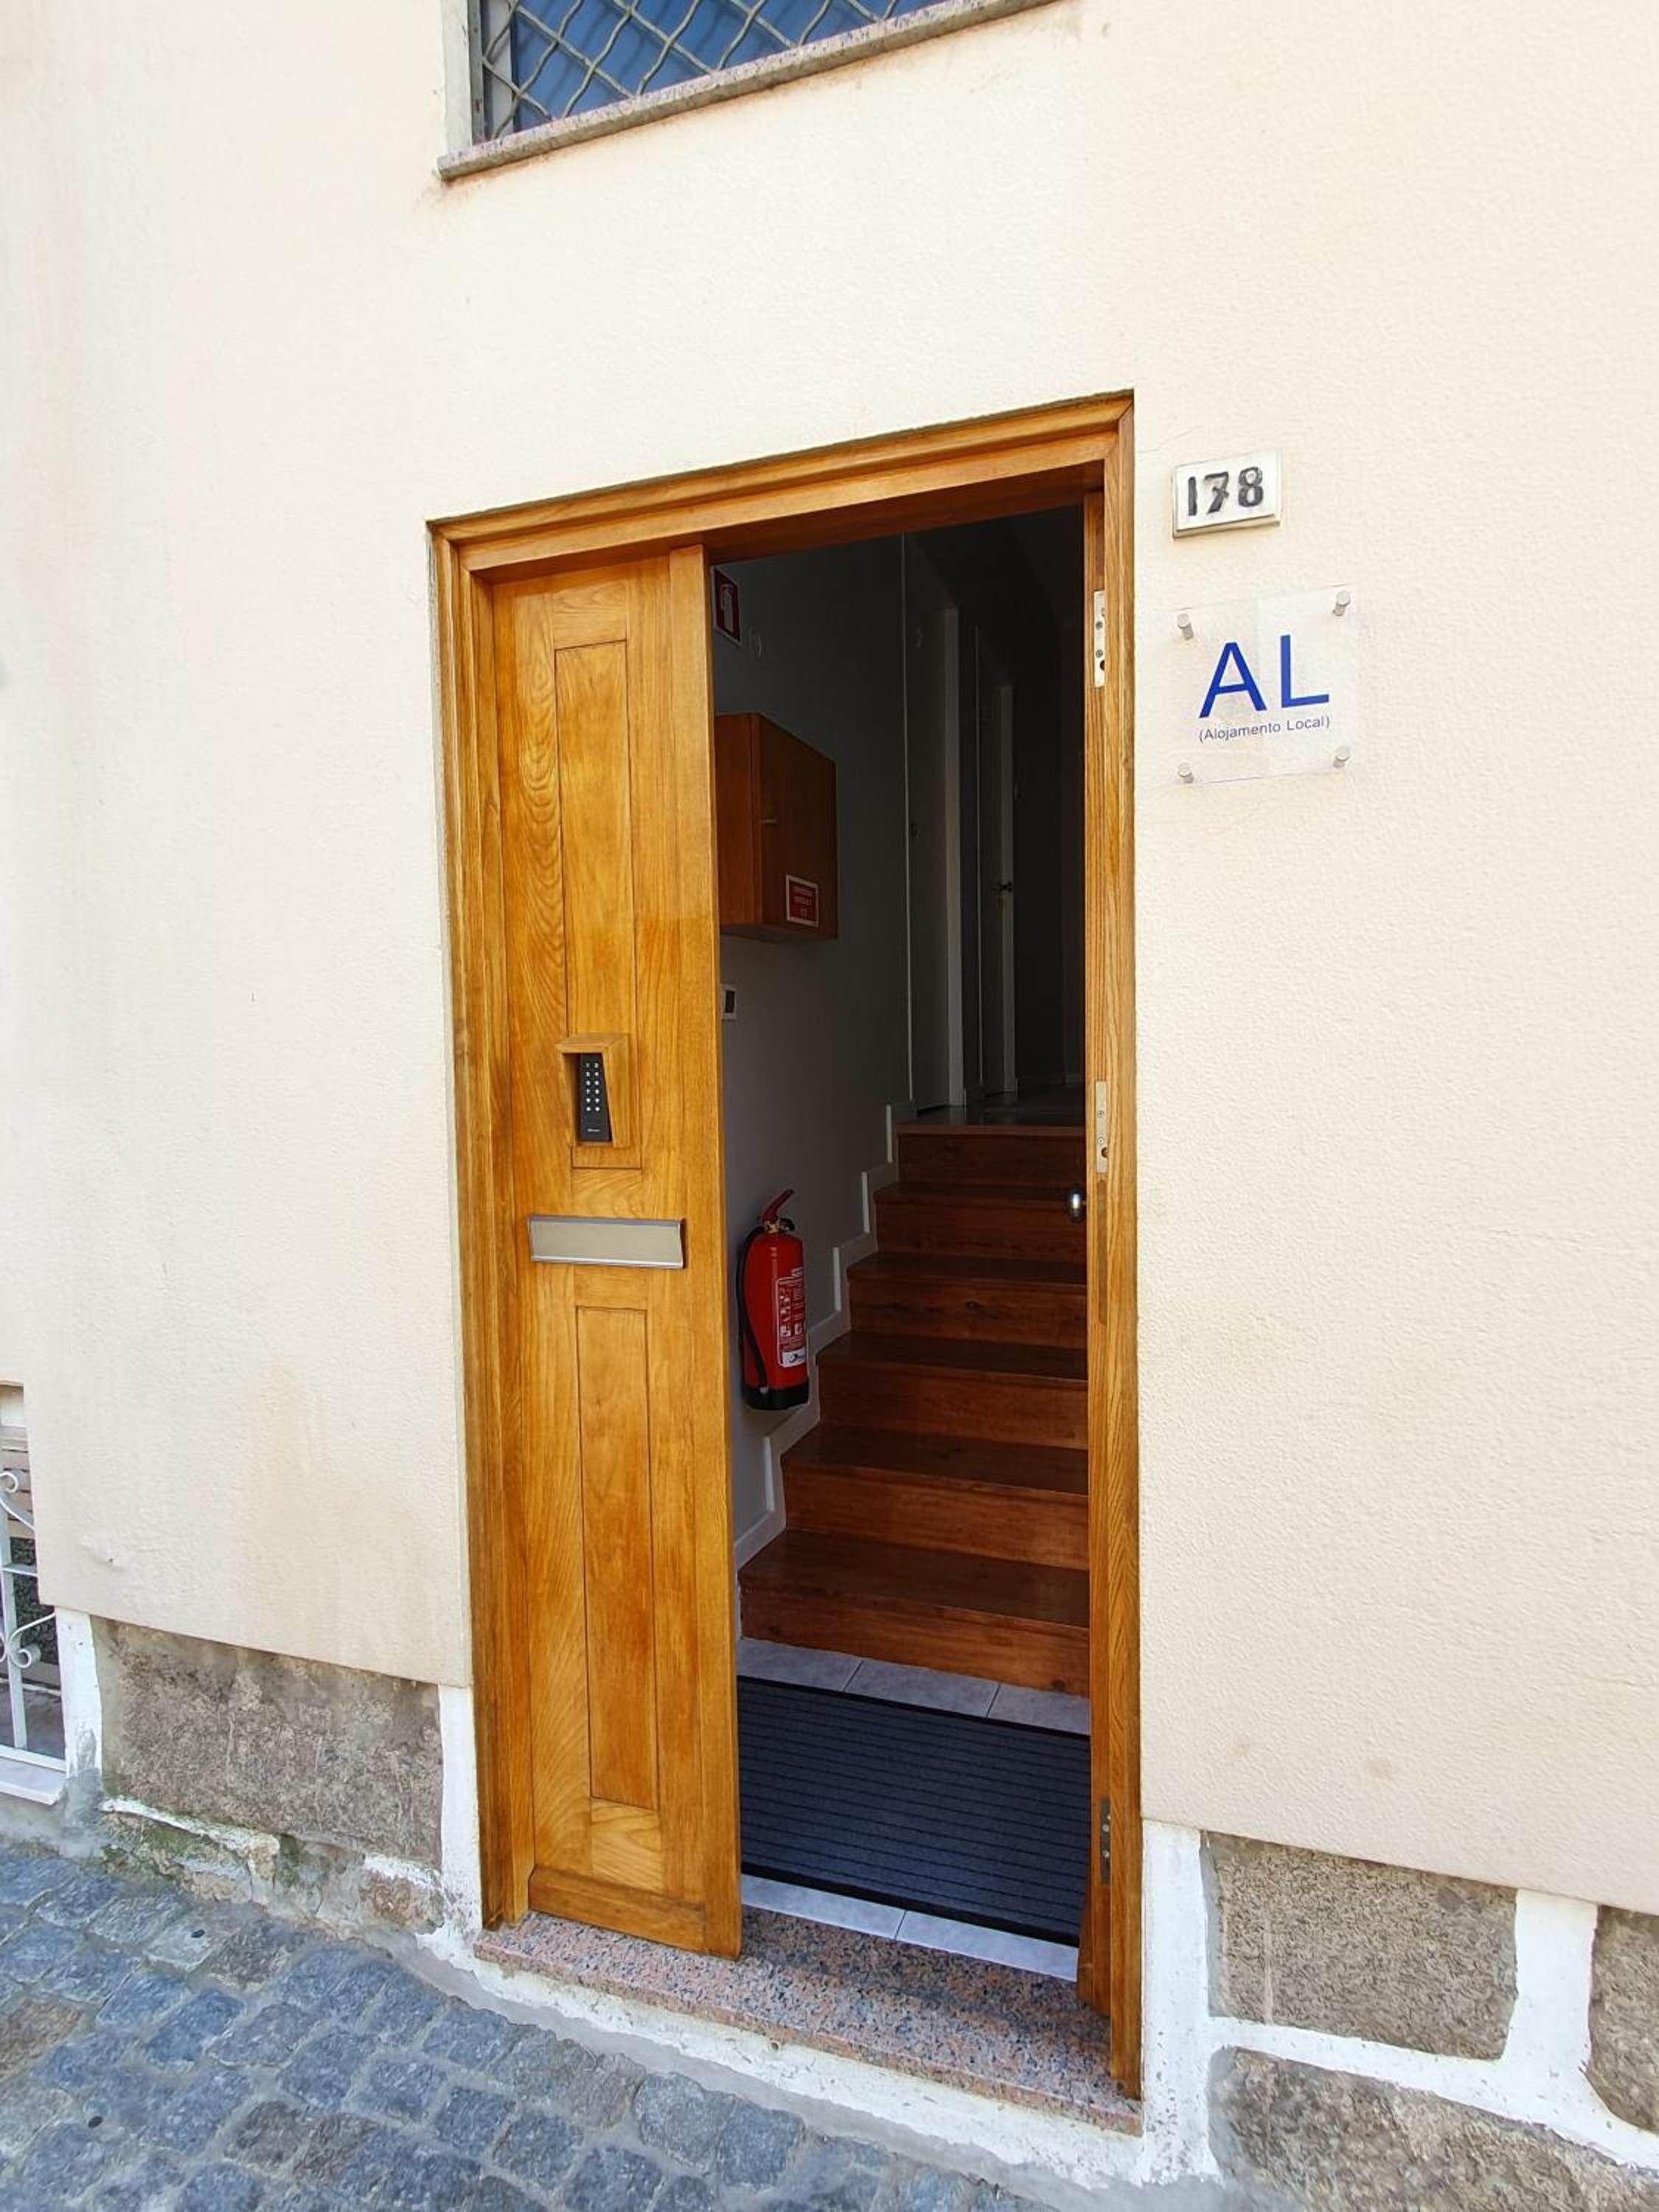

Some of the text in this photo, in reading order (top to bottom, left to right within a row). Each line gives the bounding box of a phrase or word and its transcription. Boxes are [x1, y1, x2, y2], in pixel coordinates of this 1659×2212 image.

[1188, 466, 1263, 517] 178
[1199, 634, 1329, 718] AL
[1199, 715, 1330, 743] (Alojamento Local)
